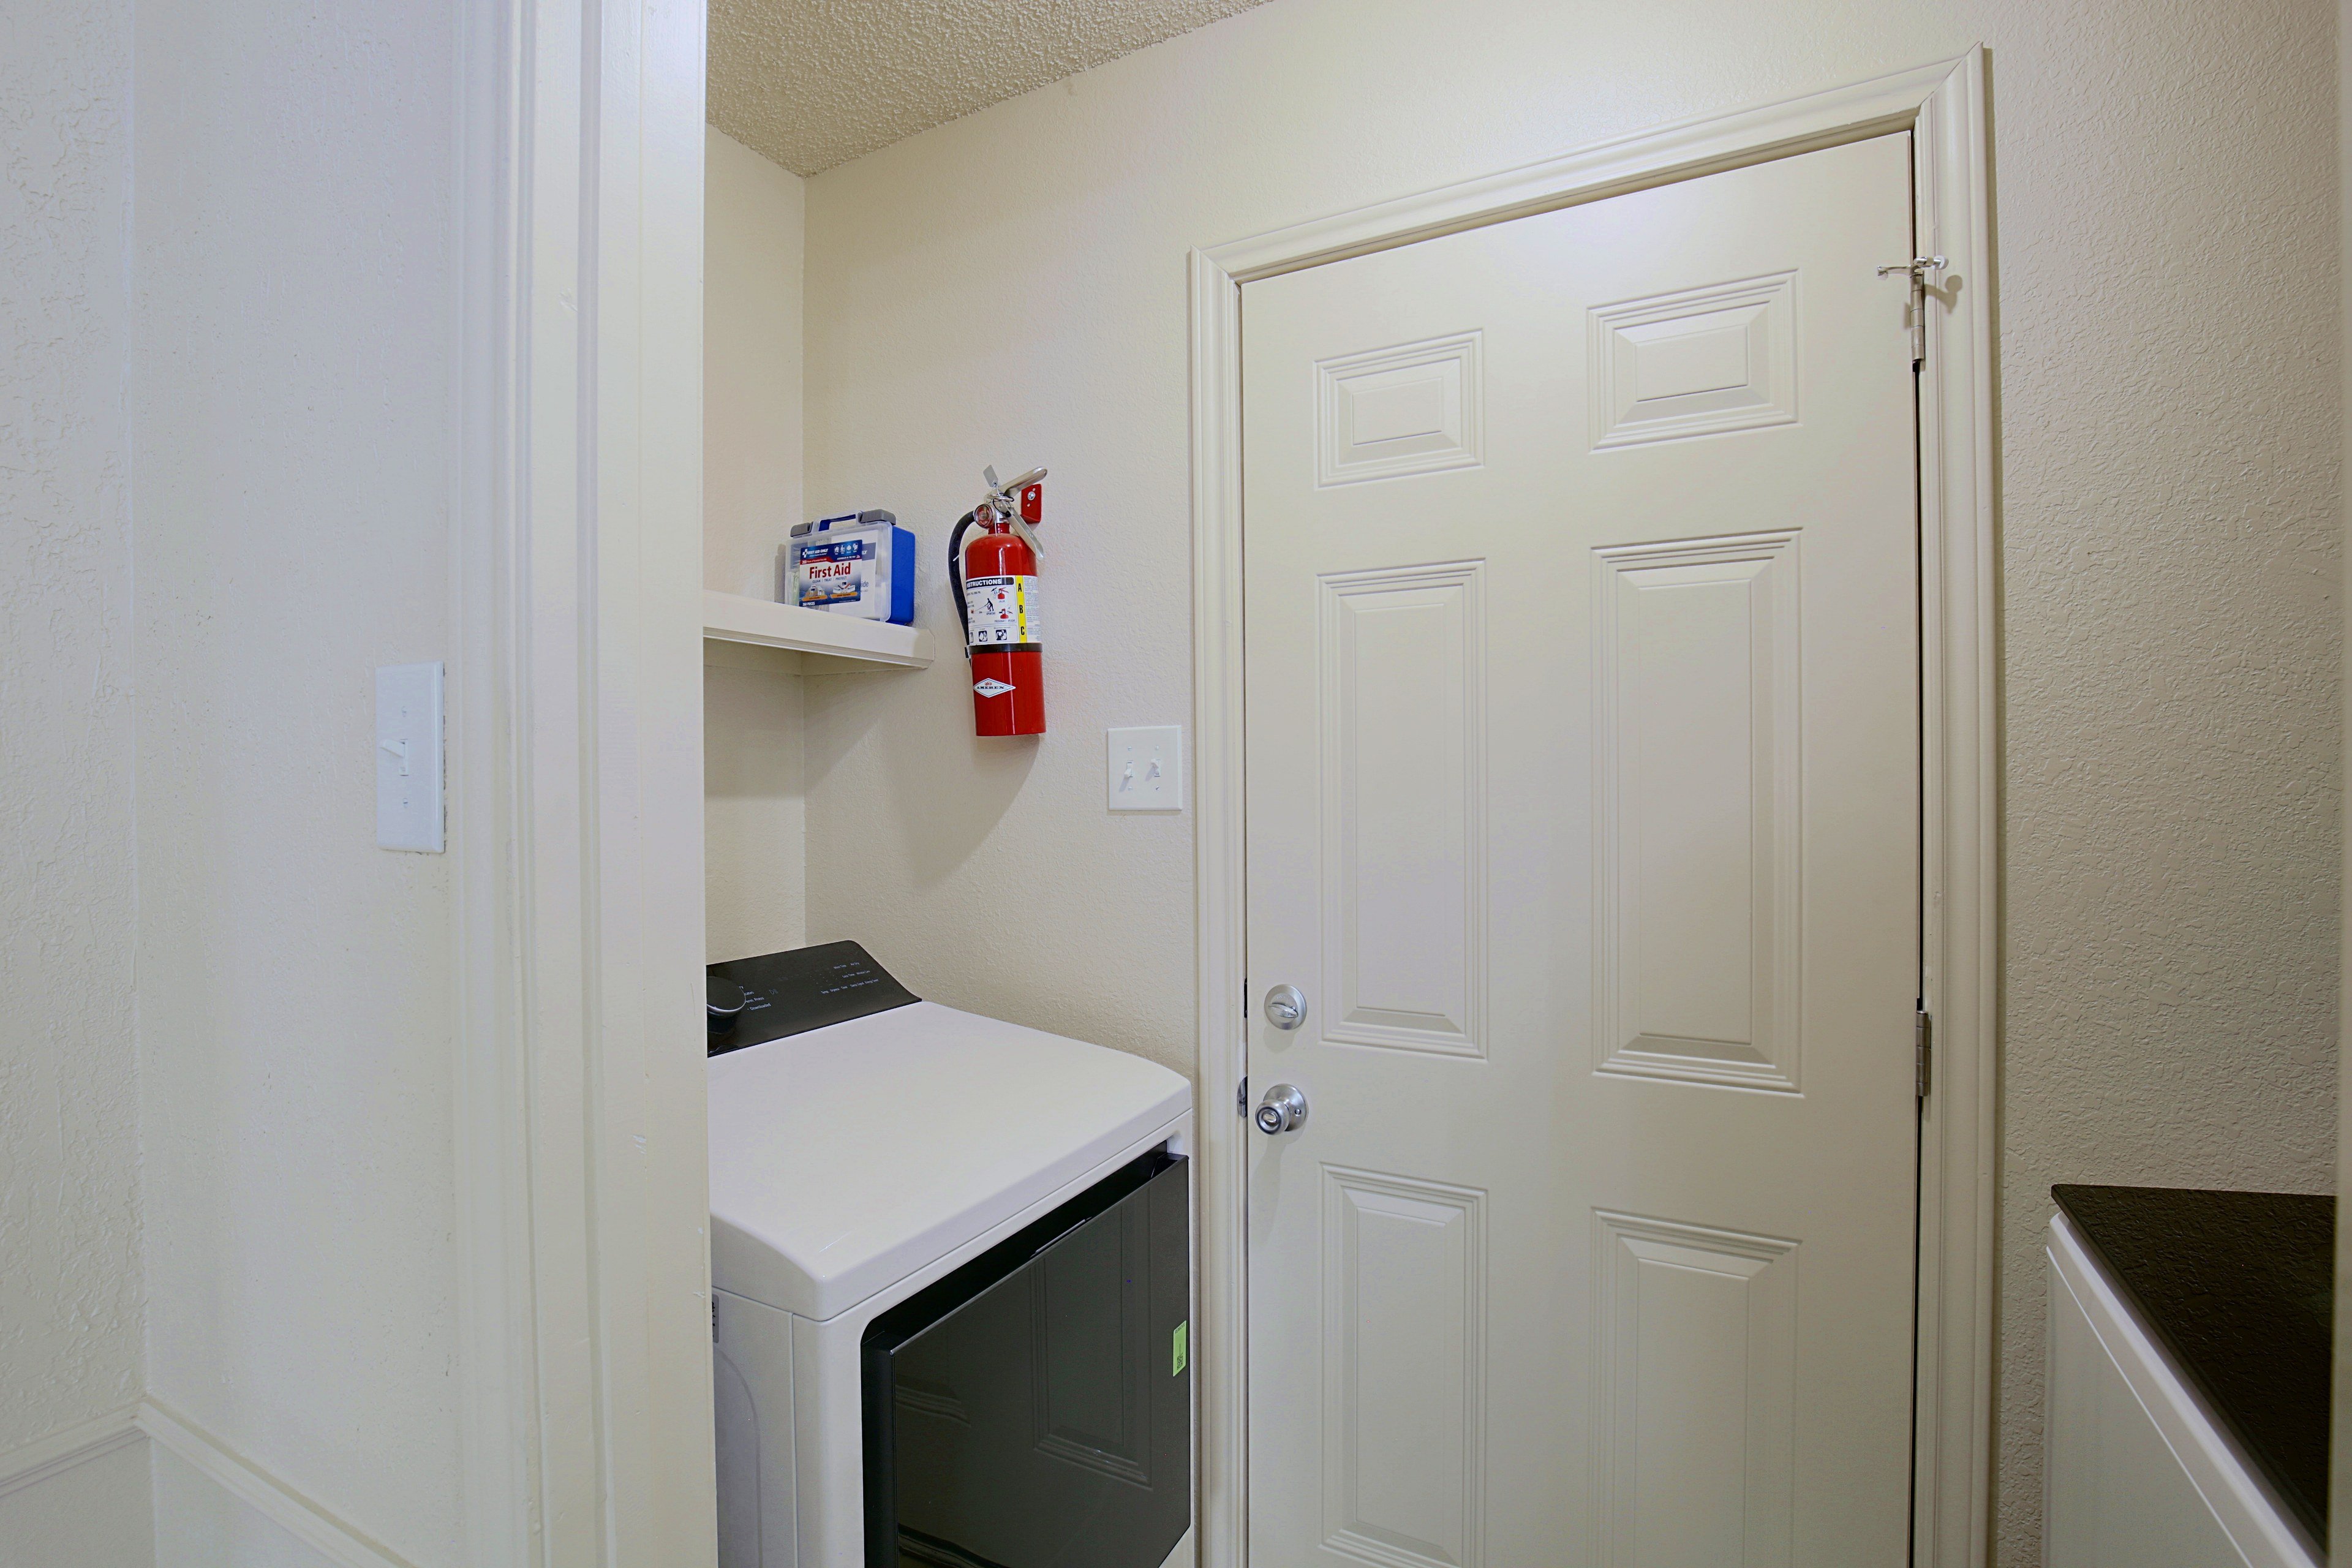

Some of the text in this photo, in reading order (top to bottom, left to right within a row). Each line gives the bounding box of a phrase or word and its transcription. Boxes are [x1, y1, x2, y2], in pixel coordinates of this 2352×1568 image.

[809, 562, 851, 579] First Aid
[967, 579, 1002, 587] NSTRUCTIONS
[1018, 583, 1022, 592] A
[1020, 626, 1025, 635] C
